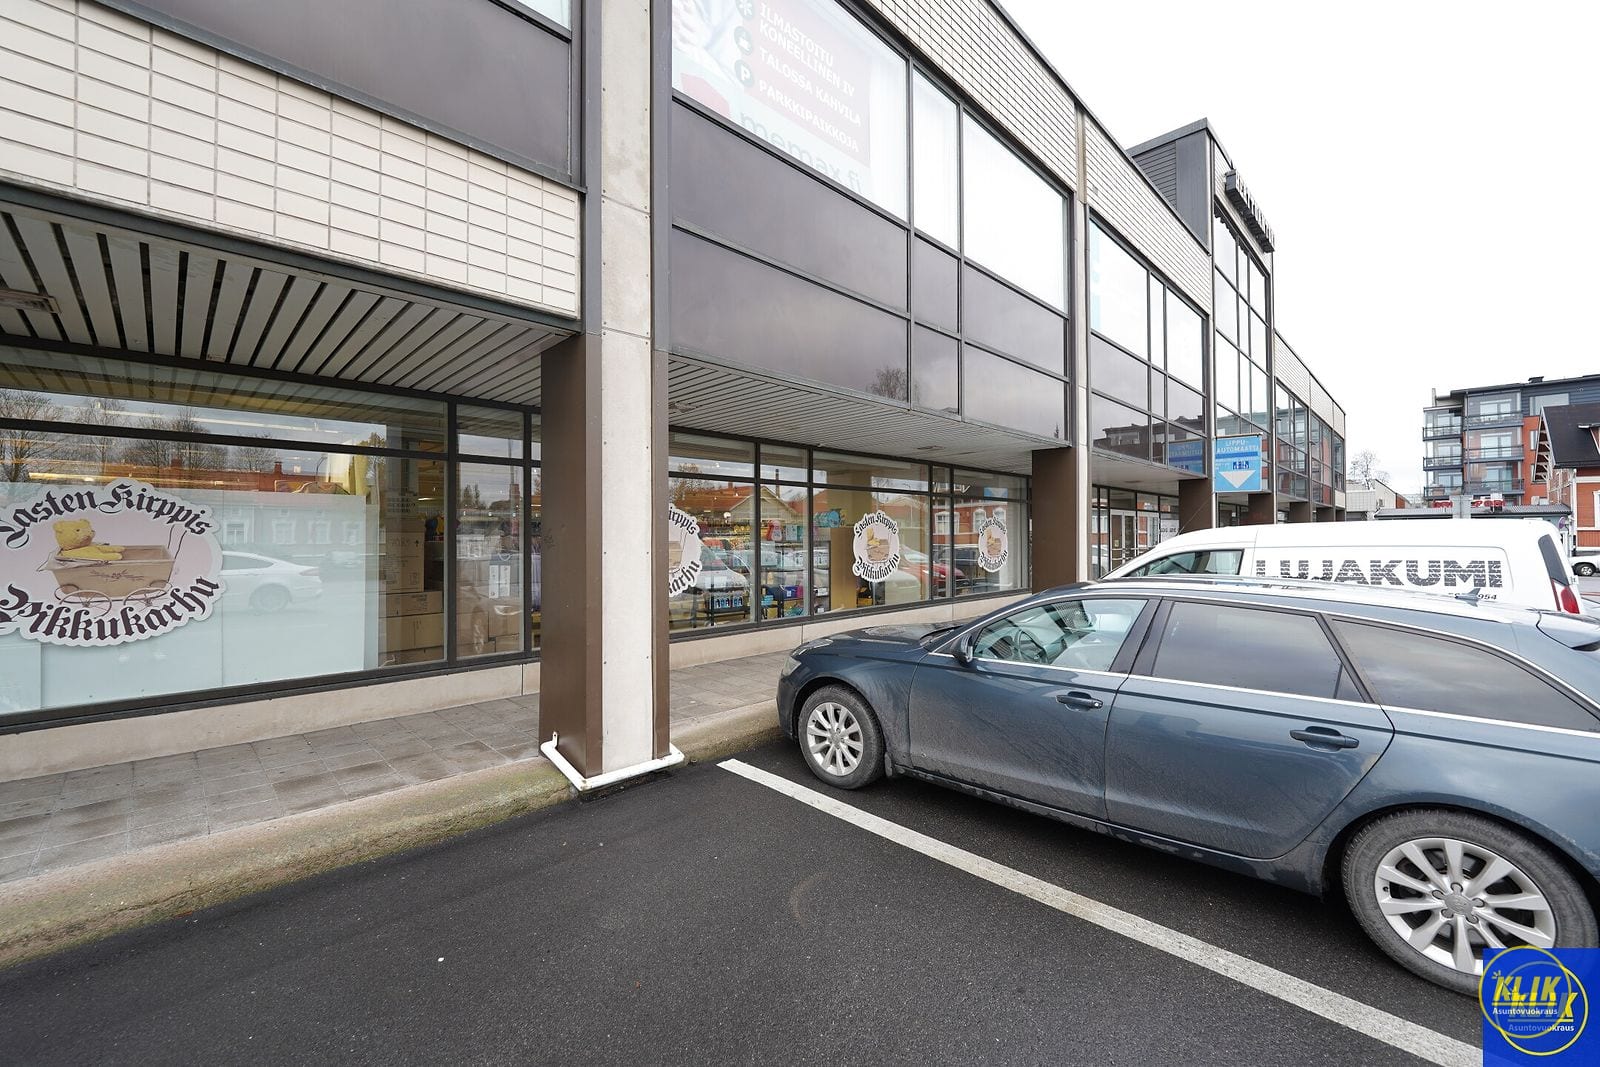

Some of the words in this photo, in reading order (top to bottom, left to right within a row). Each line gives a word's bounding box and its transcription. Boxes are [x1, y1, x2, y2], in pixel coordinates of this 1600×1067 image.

[759, 3, 834, 66] ILMASTOITU
[759, 21, 841, 89] KONEELLINEN
[842, 80, 856, 97] IV
[759, 48, 813, 93] TALOSSA
[815, 87, 861, 127] KAHVILA
[759, 80, 860, 153] PARKKIPAIKKOJA
[100, 484, 212, 535] Kirppis
[669, 507, 697, 535] irppis
[1255, 559, 1503, 588] LUJAKUMI
